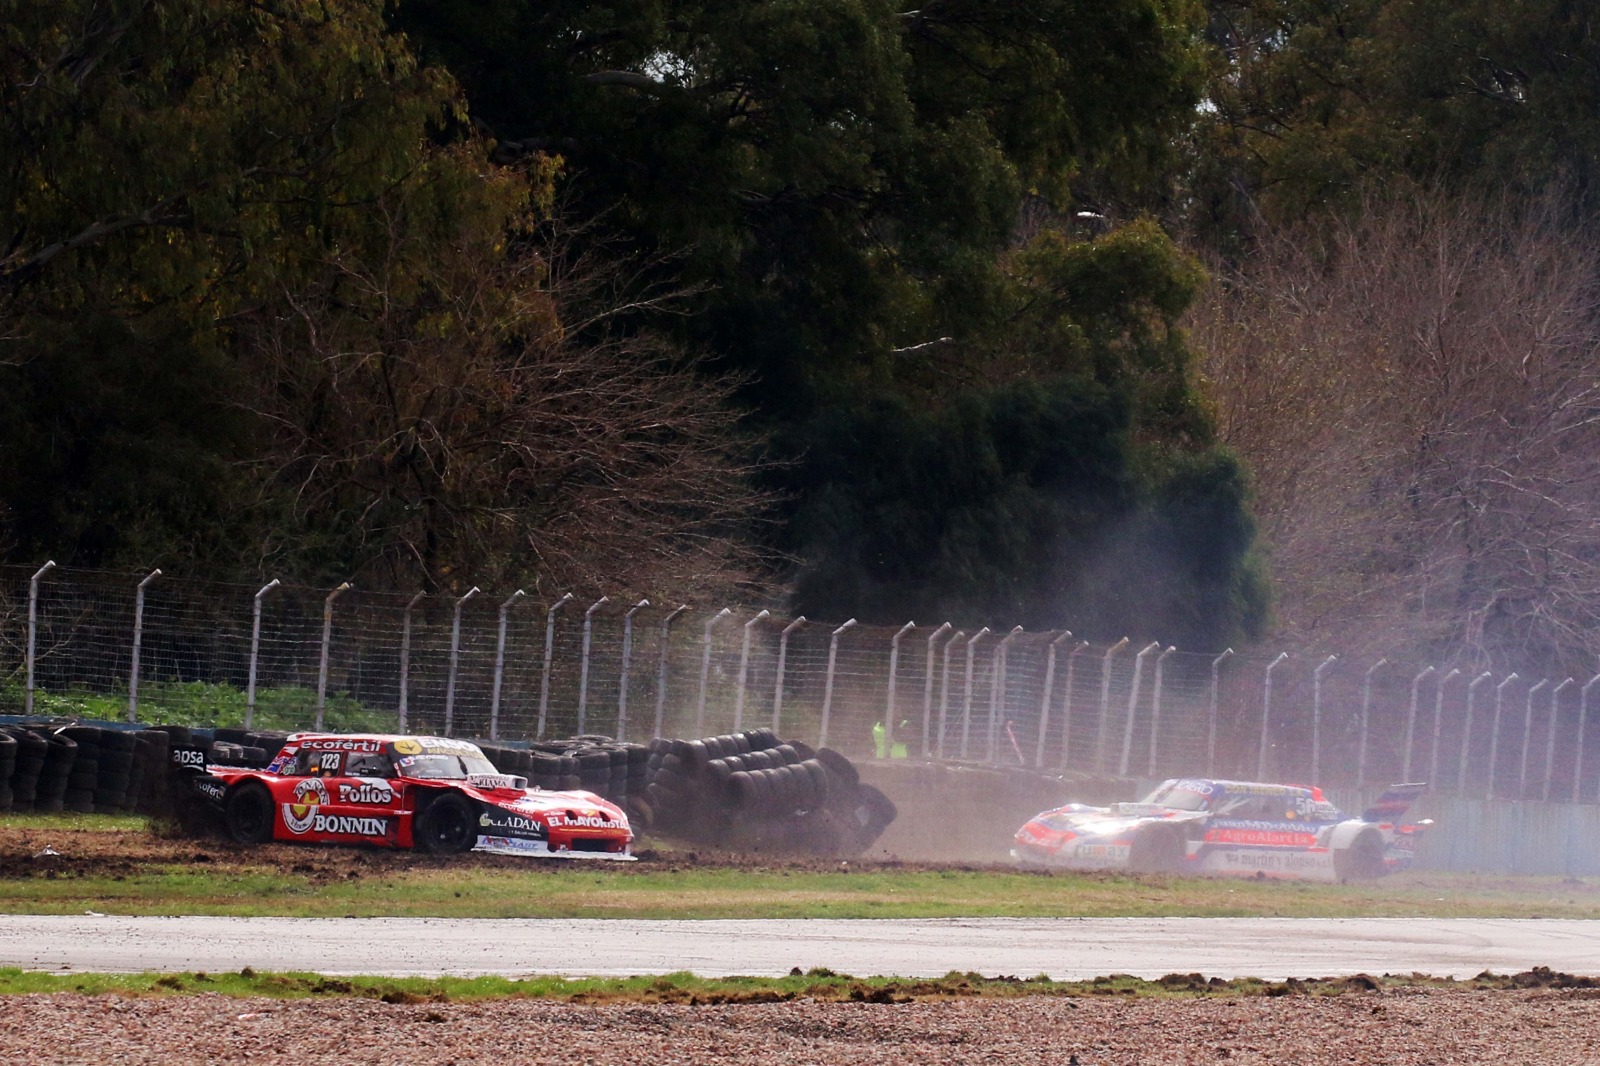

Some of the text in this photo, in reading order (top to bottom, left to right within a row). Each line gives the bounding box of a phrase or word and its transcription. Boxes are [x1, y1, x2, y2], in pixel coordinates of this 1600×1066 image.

[301, 740, 381, 752] ecofértil
[321, 753, 340, 770] 123
[339, 784, 392, 804] Pollos
[314, 814, 388, 836] BONNIN
[547, 816, 563, 828] EL
